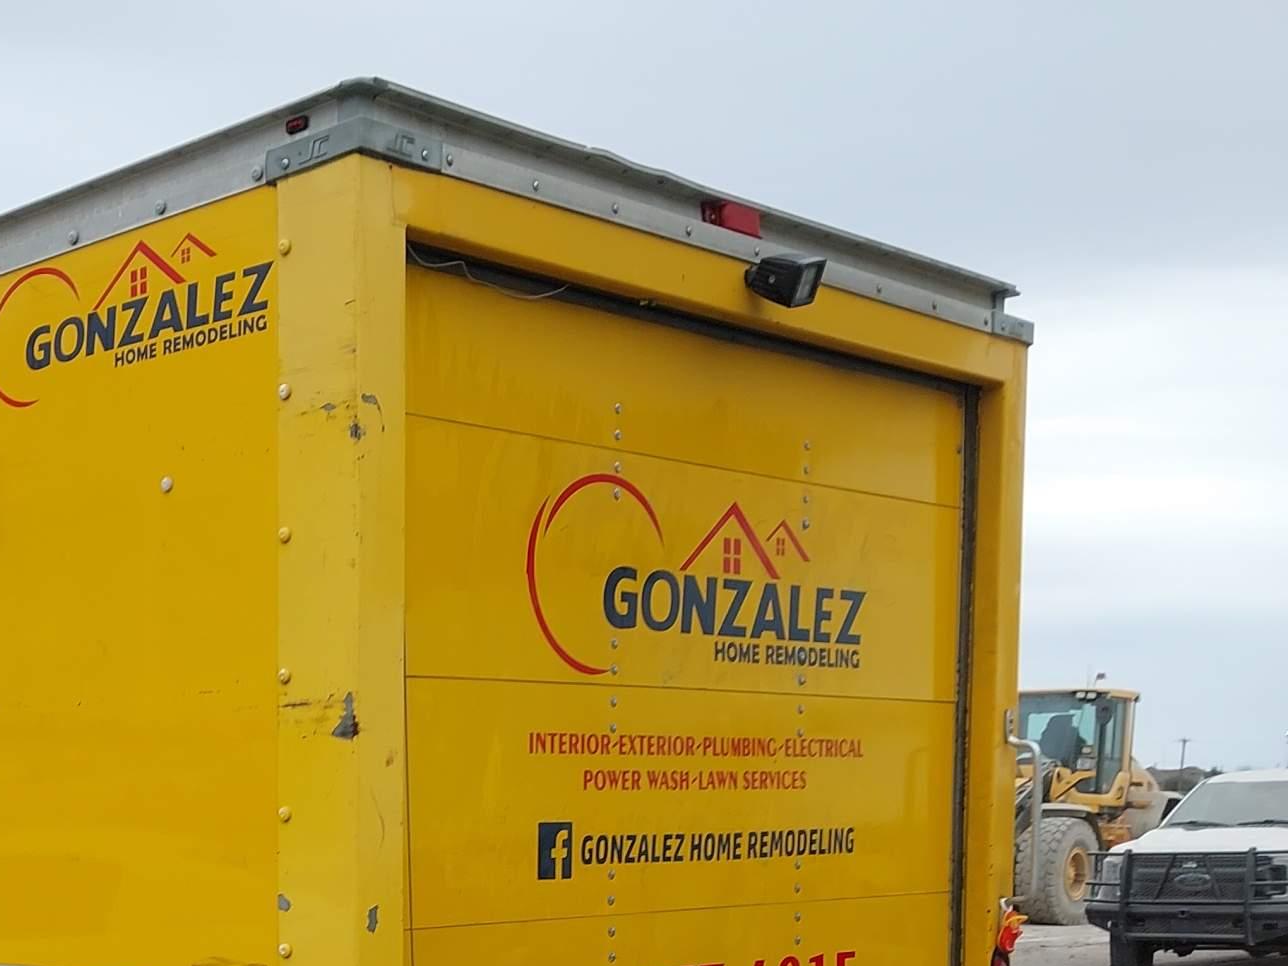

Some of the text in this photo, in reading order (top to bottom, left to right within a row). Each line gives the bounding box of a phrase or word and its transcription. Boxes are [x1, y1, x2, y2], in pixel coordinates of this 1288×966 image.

[25, 260, 274, 371] GONZALEZ
[114, 314, 268, 368] HOME REMODELING
[603, 565, 867, 645] GONZALEZ
[714, 641, 860, 669] HOME REMODELING
[583, 769, 641, 791] POWER
[743, 769, 807, 790] SERVICES
[580, 827, 855, 866] GONZALEZ HOME REMODELING
